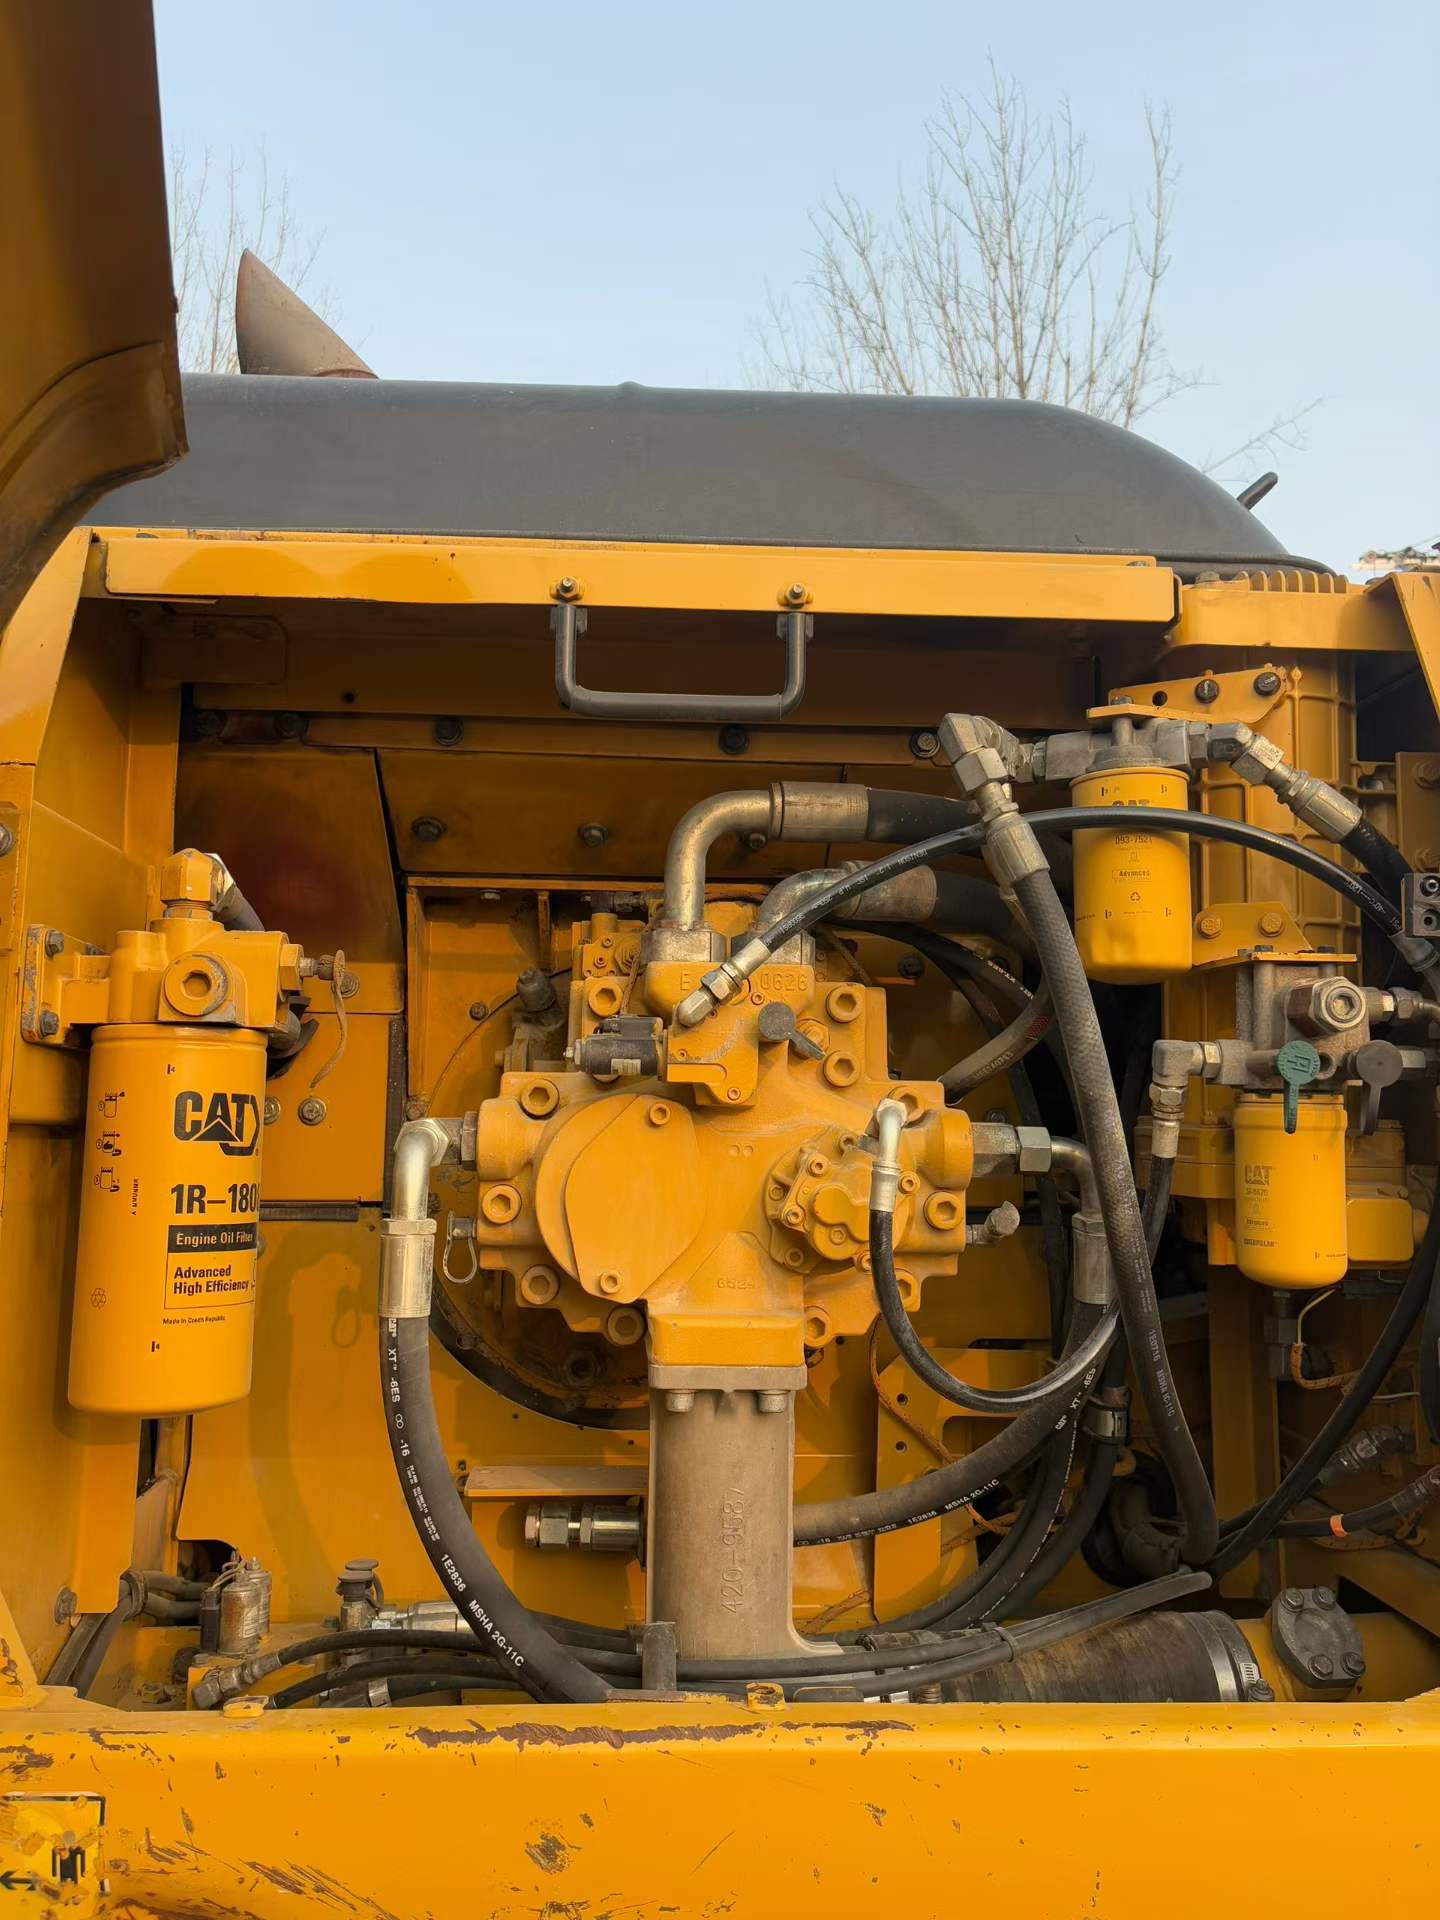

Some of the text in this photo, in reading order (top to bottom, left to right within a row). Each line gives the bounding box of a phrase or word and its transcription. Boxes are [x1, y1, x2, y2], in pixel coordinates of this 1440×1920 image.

[173, 1090, 255, 1143] CAT
[170, 1183, 260, 1215] 1R-180
[175, 1231, 254, 1248] Engine Oil Filter
[173, 1265, 232, 1279] Advanced
[173, 1279, 250, 1297] High Efficiency
[187, 1316, 205, 1325] Czech
[400, 1439, 411, 1457] -16
[907, 1510, 938, 1525] 1E2836
[944, 1496, 971, 1512] MSHA
[440, 1553, 525, 1667] 1E2836 MSHA 2G-11C
